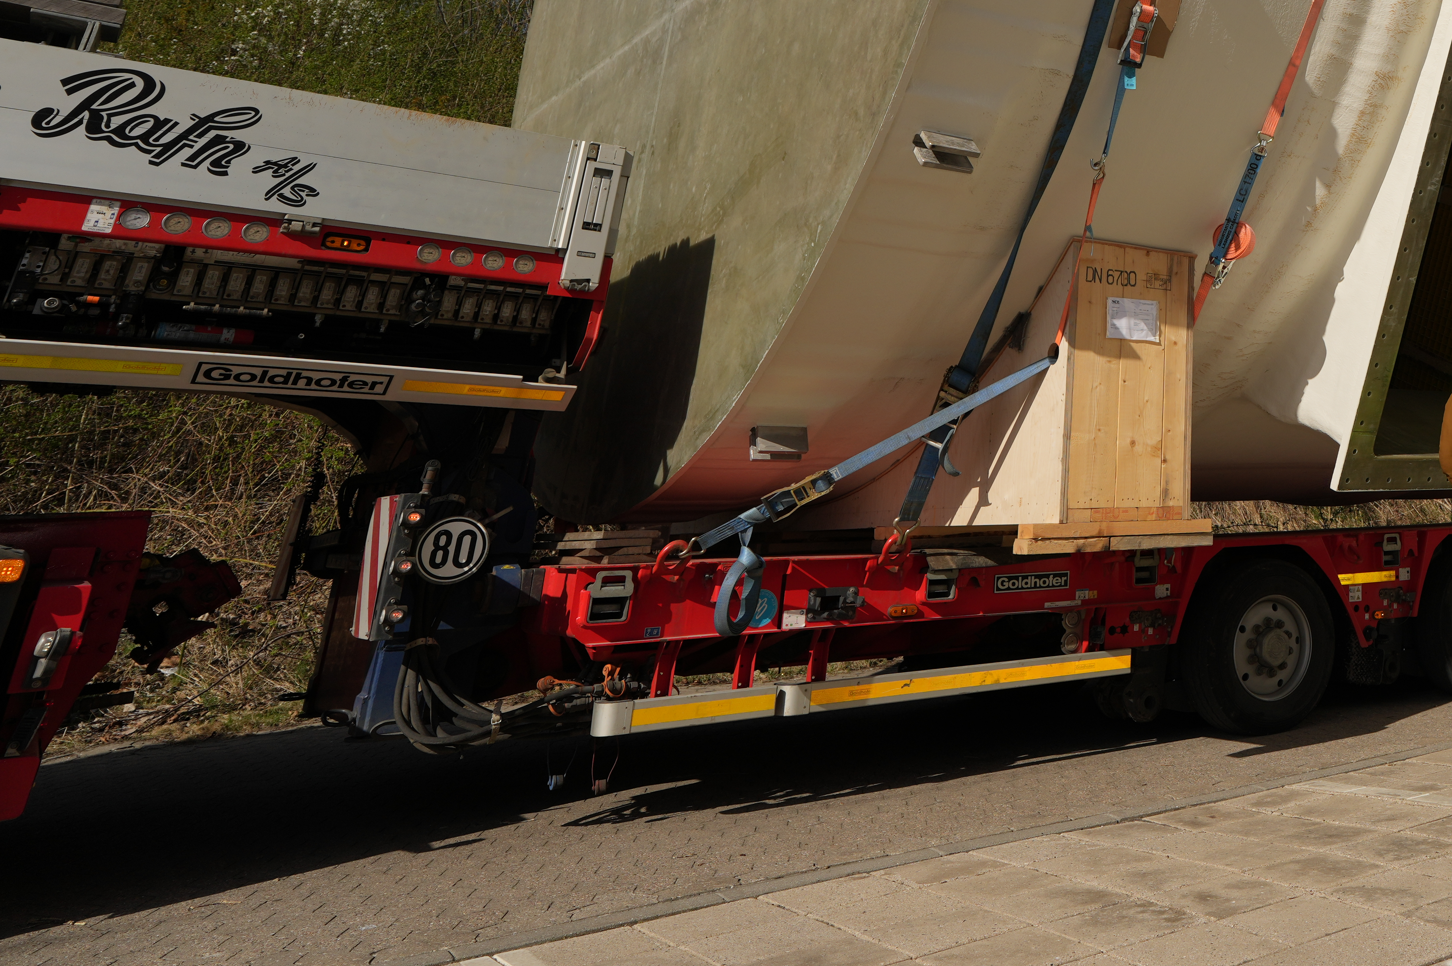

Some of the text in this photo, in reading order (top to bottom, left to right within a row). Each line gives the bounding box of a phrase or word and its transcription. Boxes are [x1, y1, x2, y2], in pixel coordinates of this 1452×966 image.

[30, 68, 262, 177] Rafn
[1243, 162, 1259, 187] 1700
[1085, 265, 1103, 284] DN
[1106, 268, 1137, 287] 6700
[202, 366, 384, 392] Goldhofer
[429, 529, 478, 570] 80
[997, 574, 1067, 590] Goldhofer
